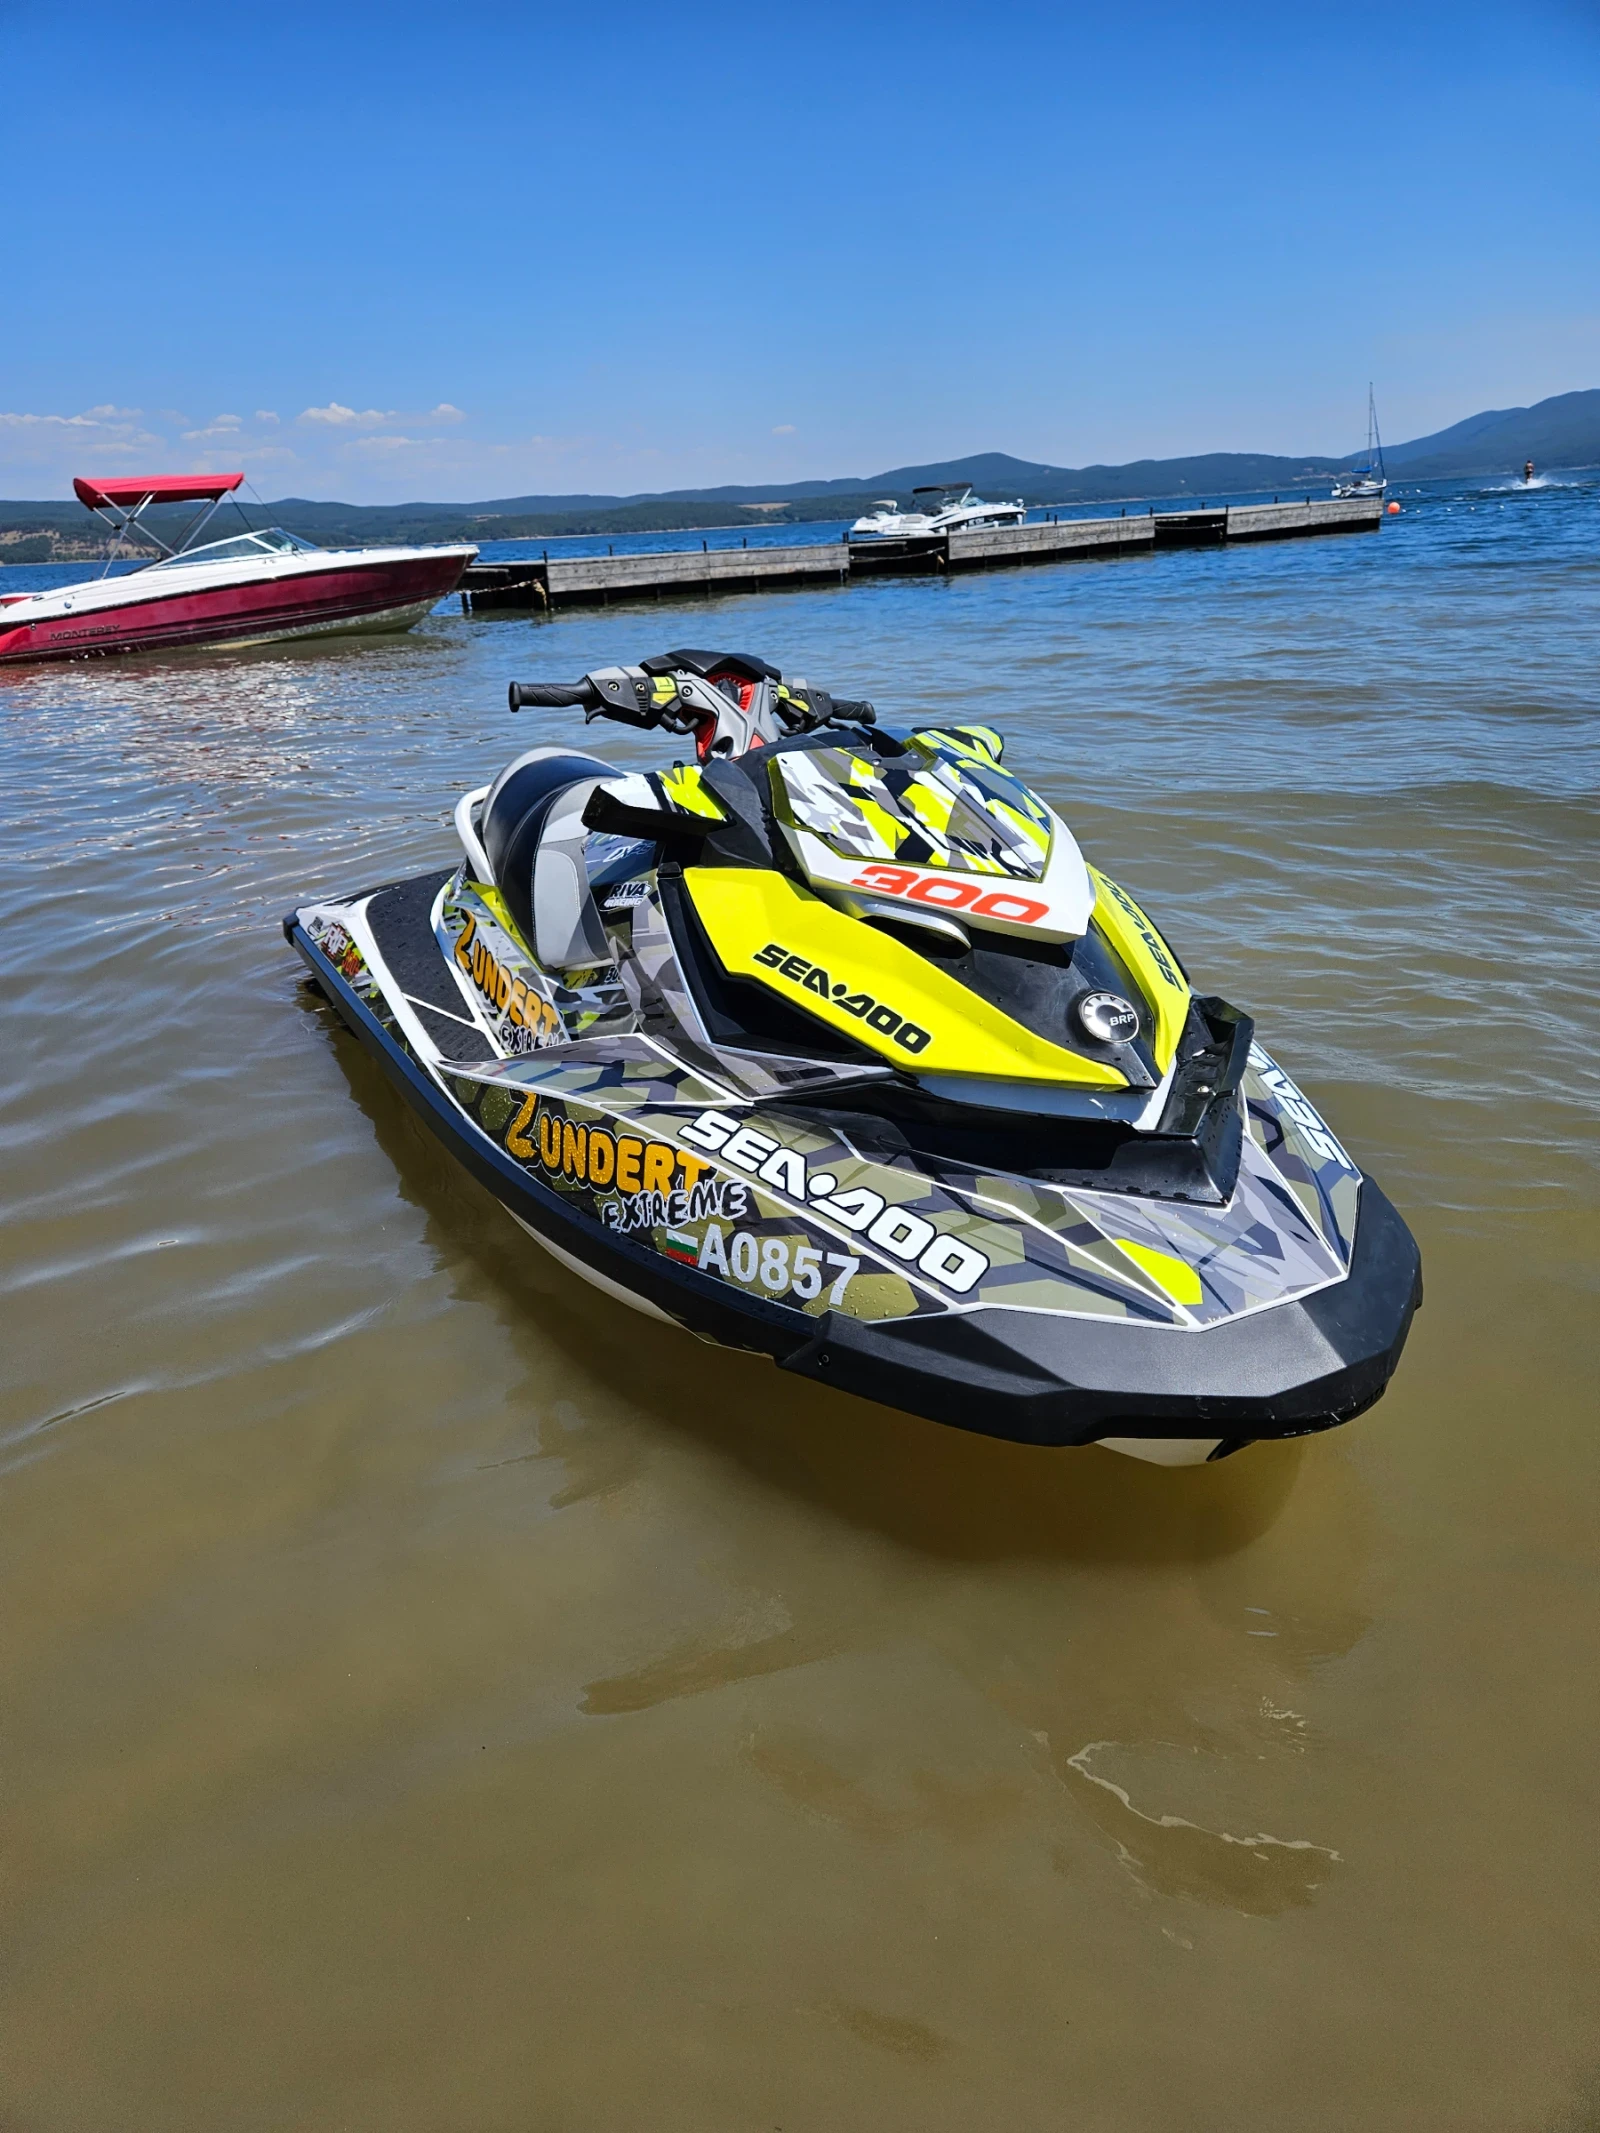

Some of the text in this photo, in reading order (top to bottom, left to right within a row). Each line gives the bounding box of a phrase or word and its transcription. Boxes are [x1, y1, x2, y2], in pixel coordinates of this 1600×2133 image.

[50, 625, 121, 640] MONTEREY
[609, 882, 649, 898] RIVA
[850, 865, 1050, 924] 300
[454, 908, 561, 1038] ZUNDERT
[1109, 1013, 1135, 1027] BRP
[506, 1089, 714, 1199] ZUNDERT
[601, 1178, 748, 1234] EXTREME
[697, 1223, 860, 1306] A0857
